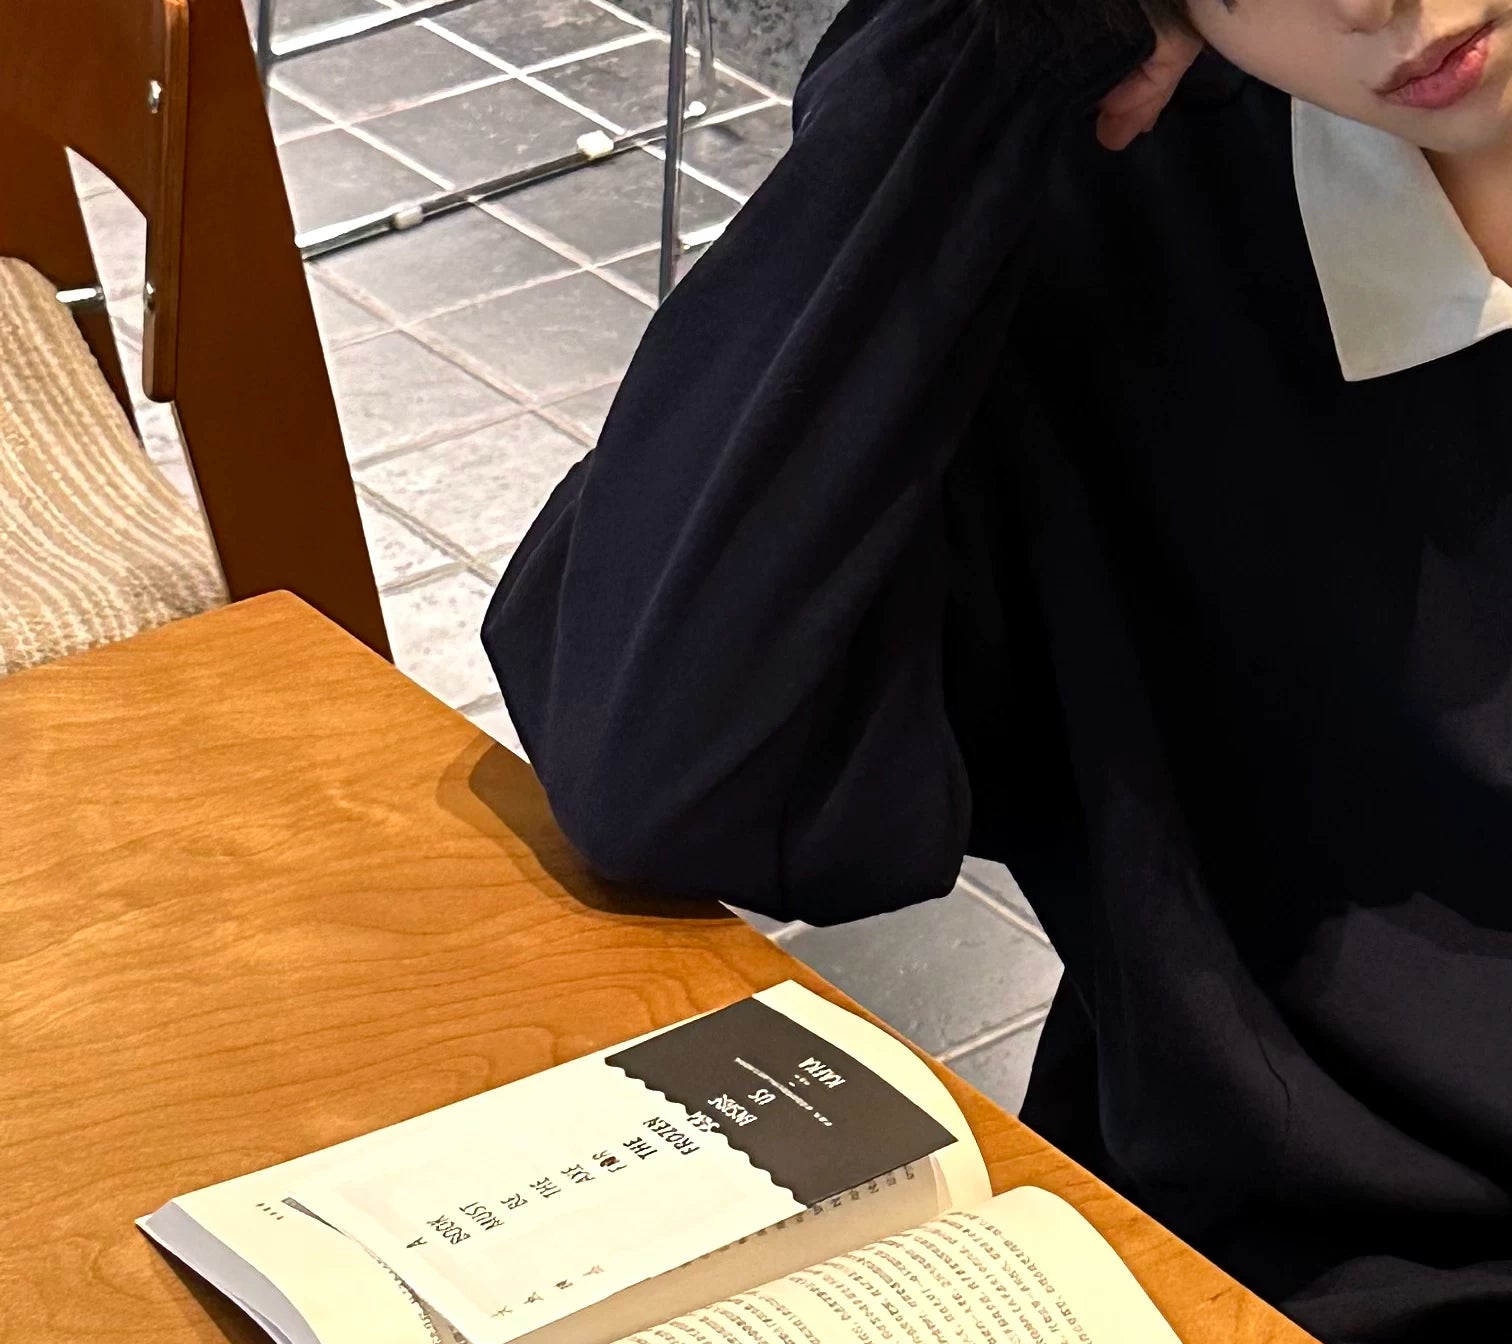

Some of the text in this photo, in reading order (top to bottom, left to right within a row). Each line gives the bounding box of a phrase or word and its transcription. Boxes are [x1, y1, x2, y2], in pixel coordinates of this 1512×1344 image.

[798, 1057, 846, 1088] KAFKA
[747, 1089, 776, 1105] US
[643, 1117, 700, 1155] FROZEN
[623, 1137, 658, 1160] THE
[560, 1164, 596, 1183] AXE
[529, 1176, 561, 1199] THE
[501, 1193, 528, 1209] BE
[459, 1202, 504, 1230] MUST
[427, 1214, 471, 1244] BOOK
[406, 1236, 427, 1248] A
